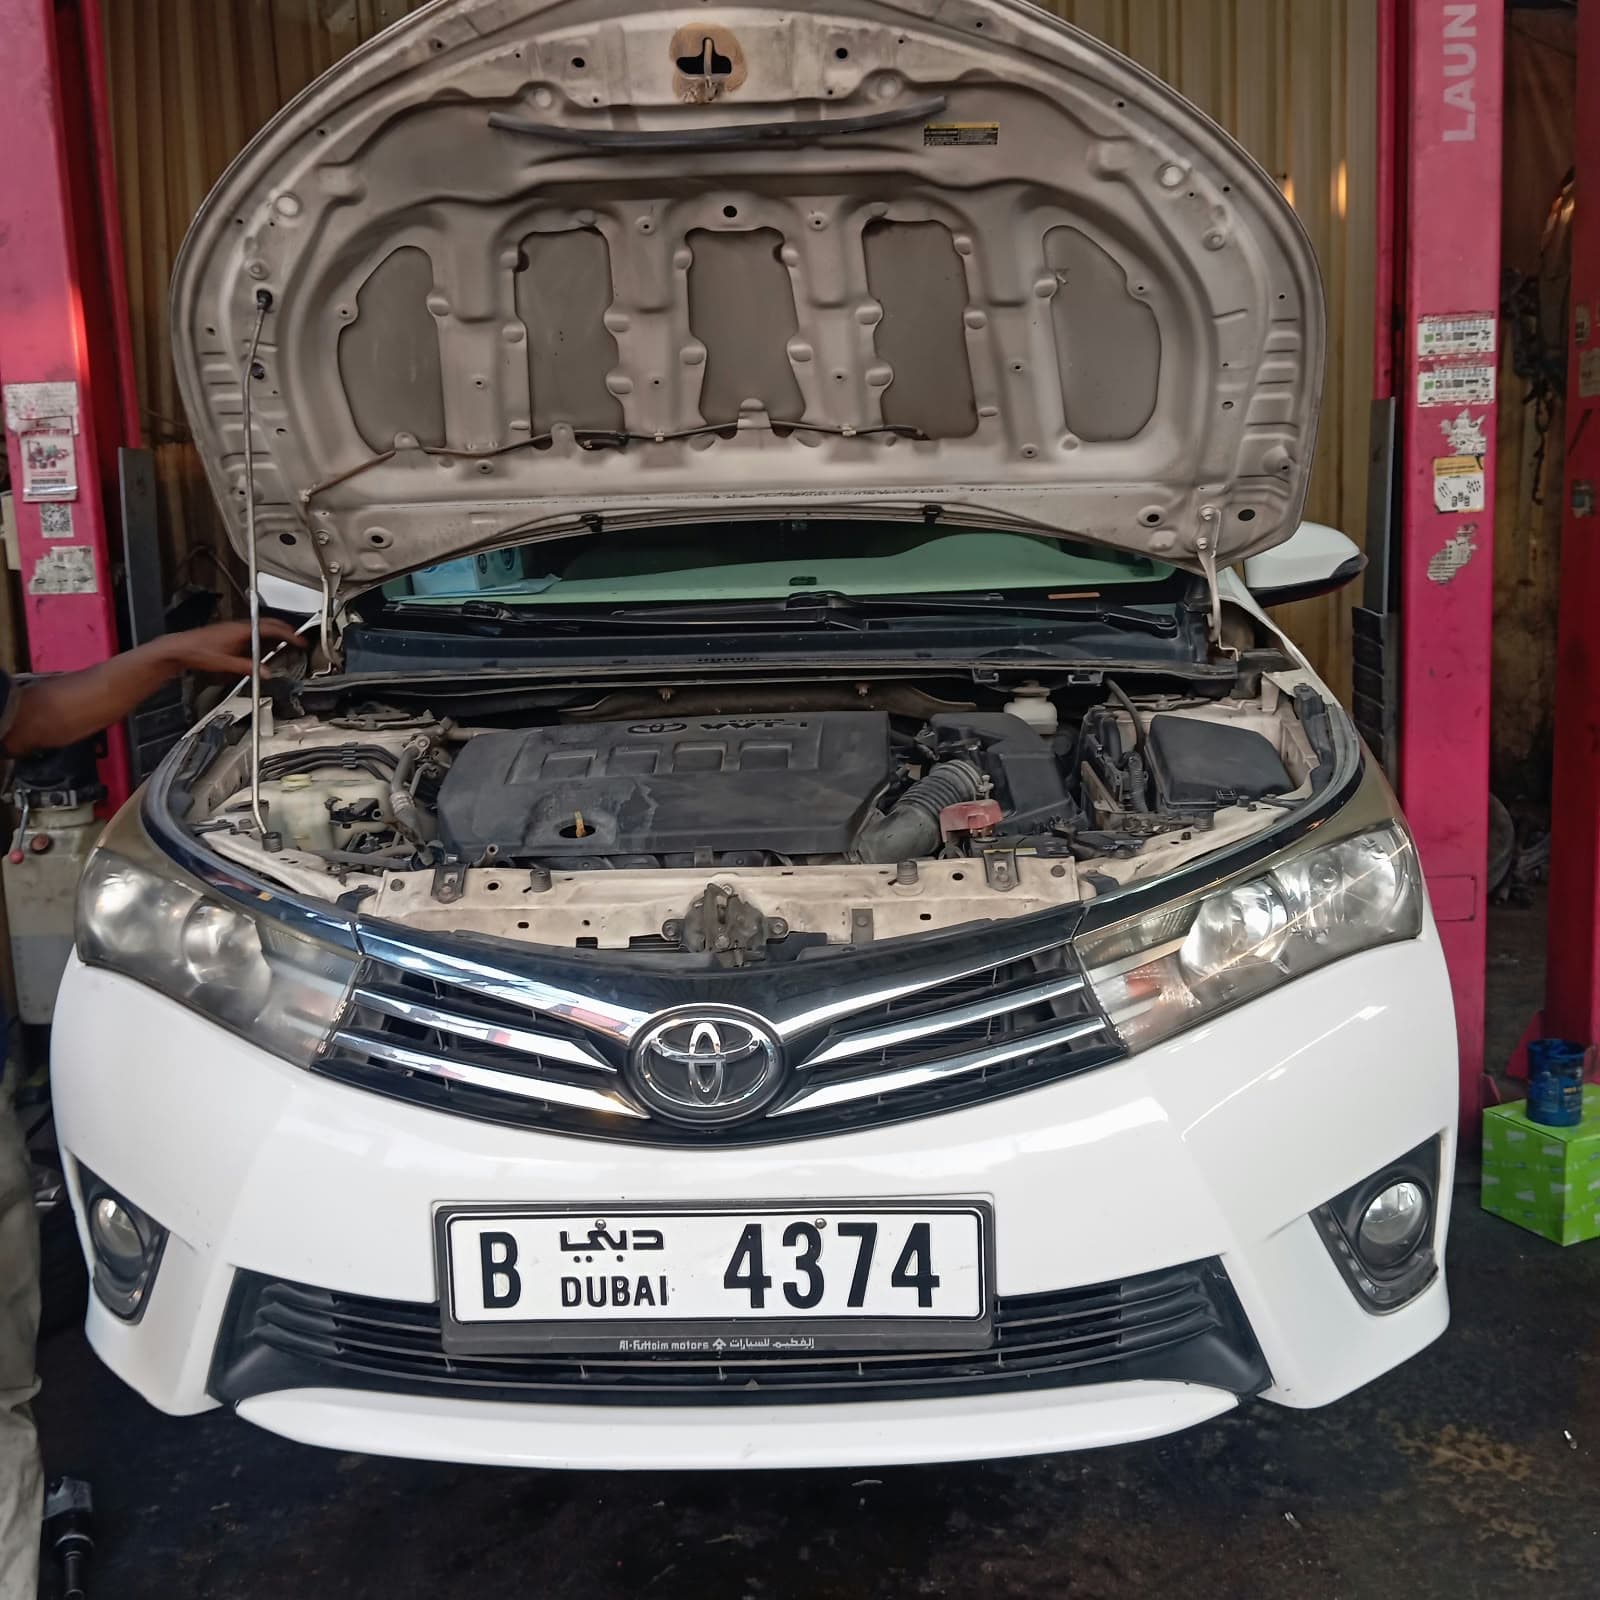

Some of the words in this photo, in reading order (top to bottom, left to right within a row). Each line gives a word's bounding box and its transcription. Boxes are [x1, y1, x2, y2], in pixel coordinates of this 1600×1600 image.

[560, 1229, 664, 1263] دبي
[480, 1232, 521, 1309] B
[724, 1222, 940, 1309] 4374
[561, 1276, 669, 1307] DUBAI
